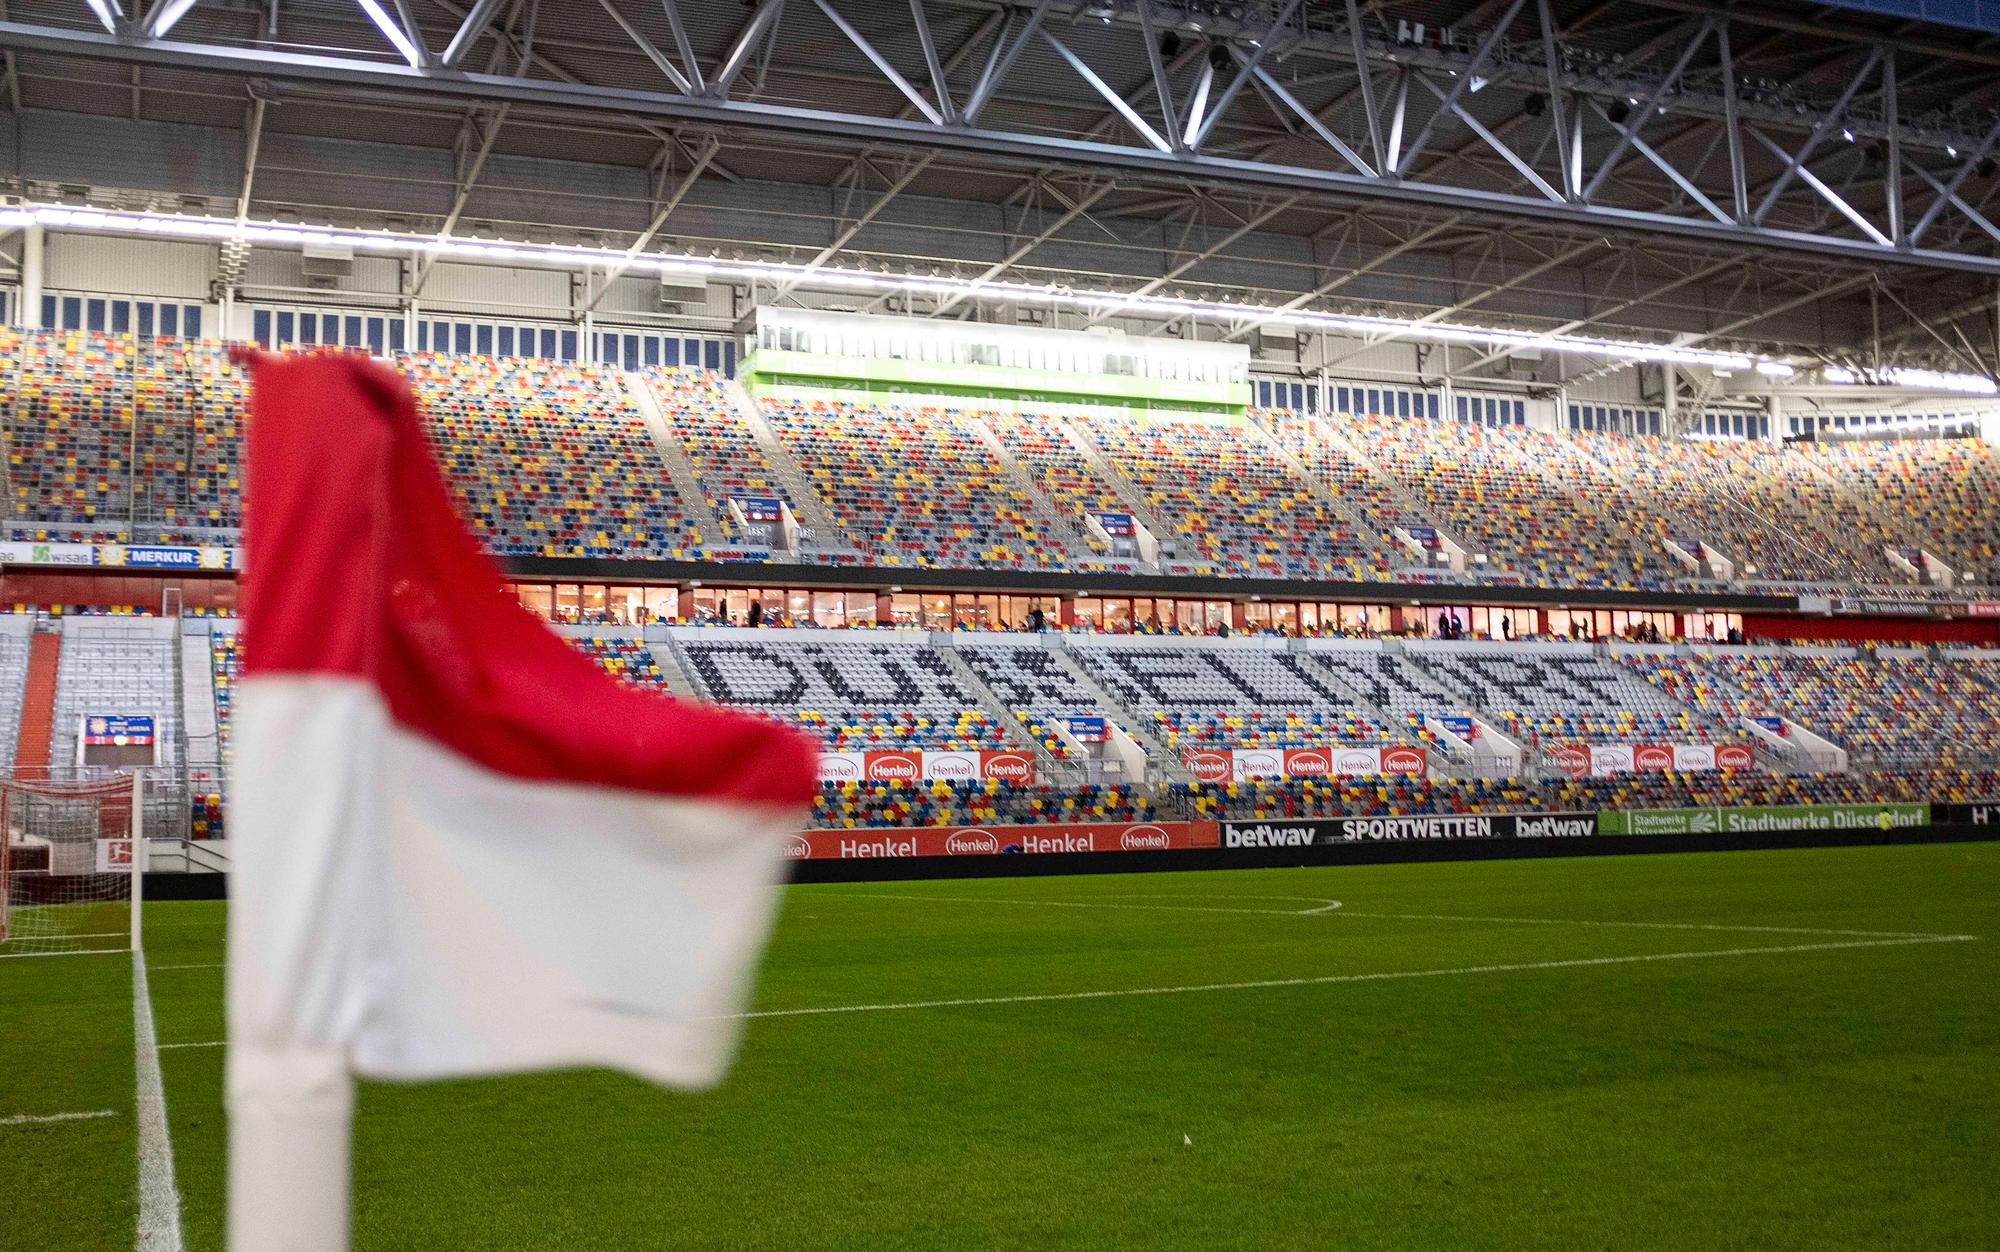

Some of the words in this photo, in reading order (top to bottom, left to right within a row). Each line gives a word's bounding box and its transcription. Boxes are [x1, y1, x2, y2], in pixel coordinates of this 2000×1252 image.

[132, 551, 193, 563] MERKUR
[874, 763, 914, 777] Henkel
[932, 763, 972, 776] Henkel
[989, 763, 1028, 776] Henkel
[1189, 761, 1226, 774] Henkel
[1242, 760, 1277, 772] Henkel
[1291, 760, 1326, 771] Henkel
[1340, 760, 1374, 771] Henkel
[1388, 759, 1421, 770] Henkel
[1634, 814, 1687, 826] Stadtwerke
[1728, 810, 1830, 832] Stadtwerke
[1833, 809, 1924, 829] Düssedorf
[1342, 816, 1491, 841] SPORTWETTEN
[840, 836, 917, 859] Henkel
[951, 838, 994, 852] Henkel
[1023, 832, 1094, 854] Henkel
[1125, 834, 1165, 848] Henkel
